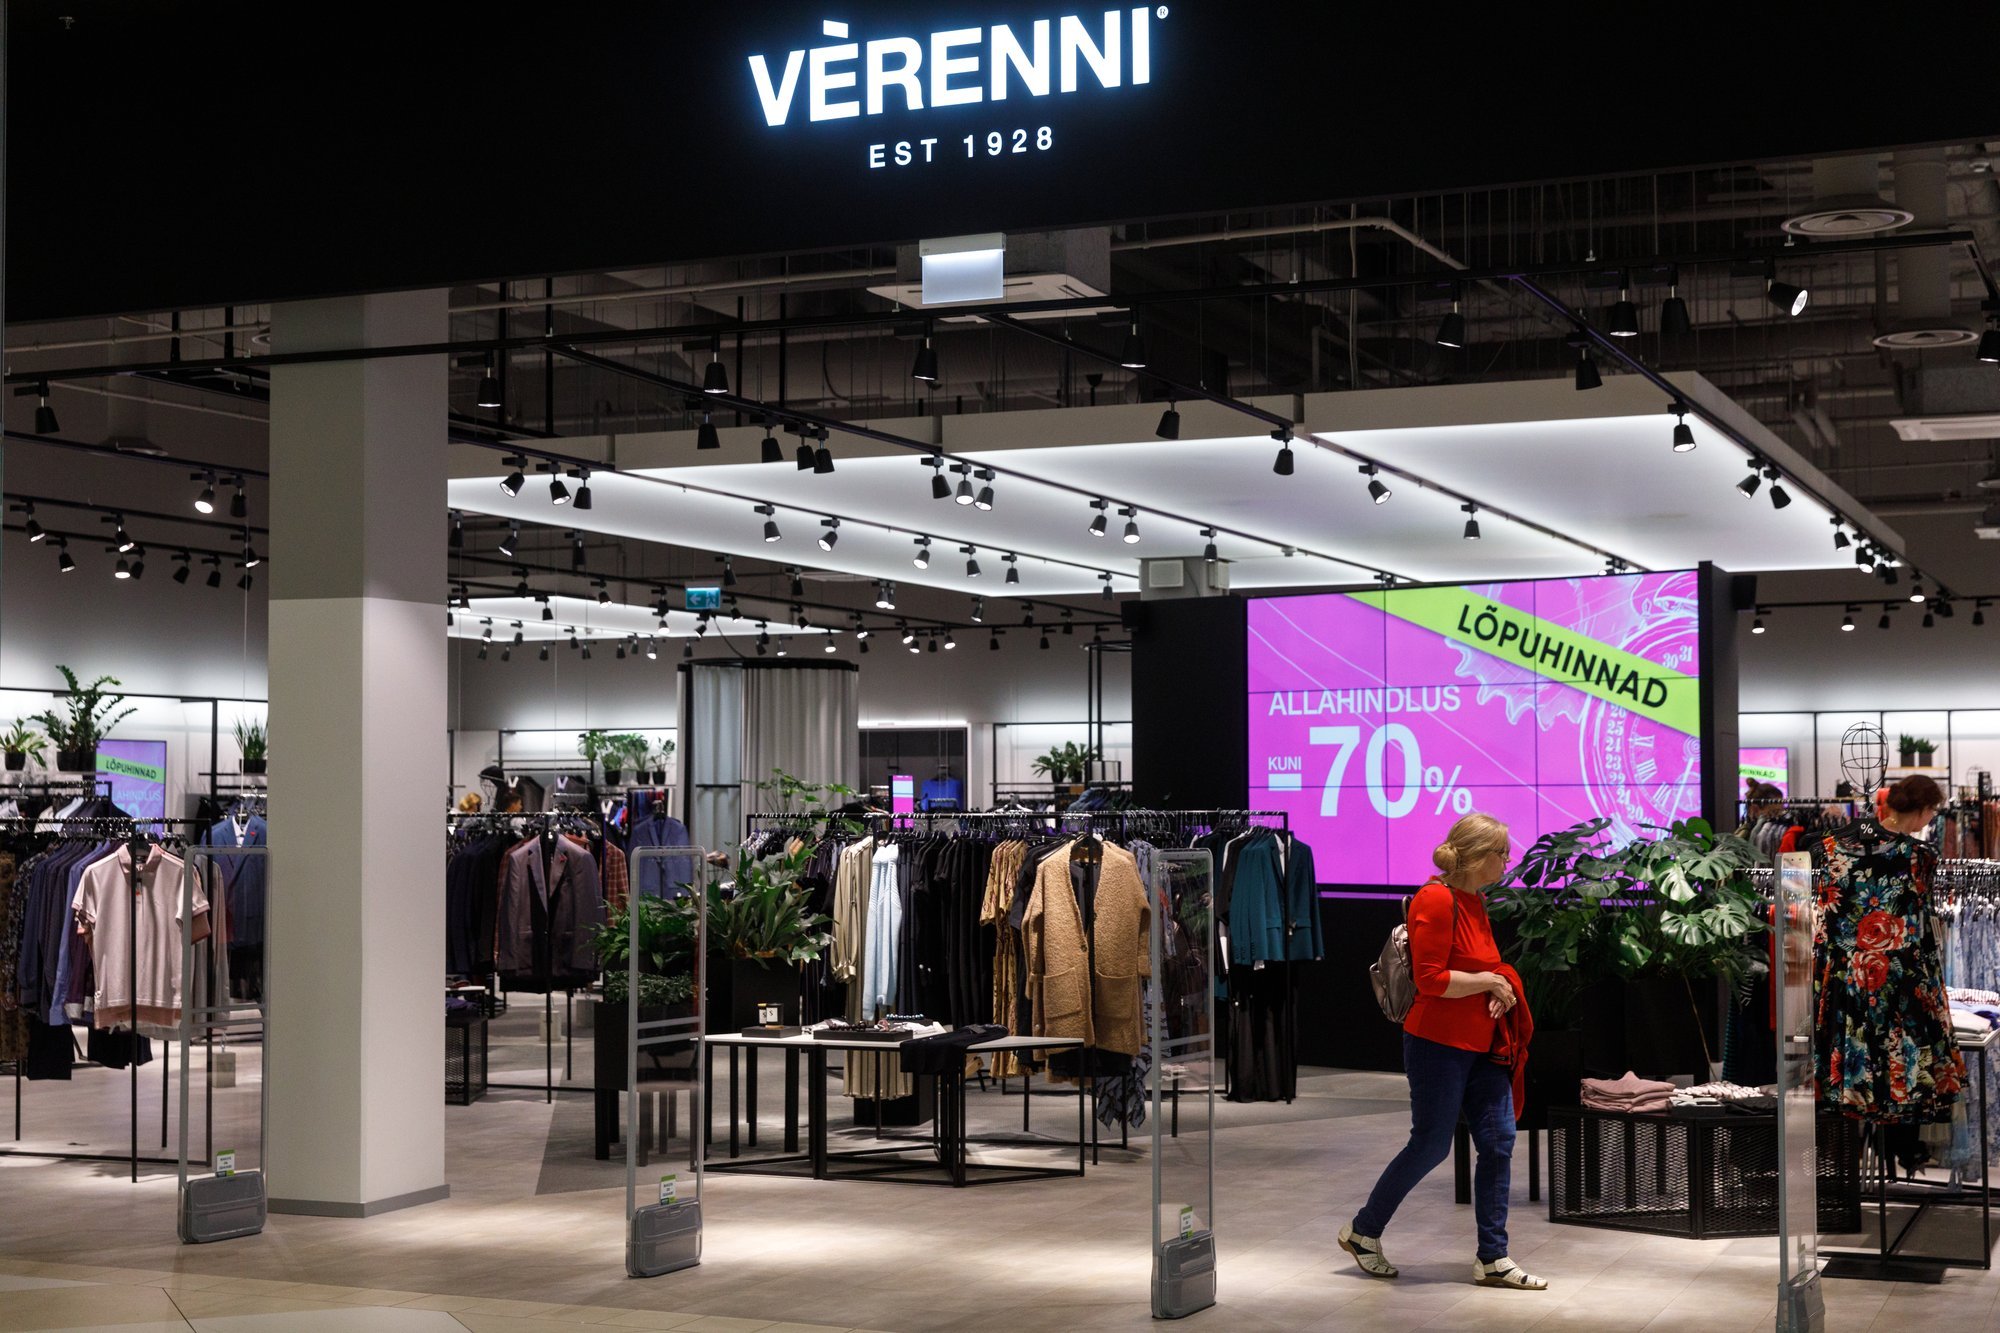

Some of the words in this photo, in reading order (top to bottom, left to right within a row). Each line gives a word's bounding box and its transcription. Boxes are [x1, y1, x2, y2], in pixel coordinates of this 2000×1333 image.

[869, 138, 938, 169] EST
[963, 126, 1054, 158] 1928
[1457, 604, 1668, 708] LÕPUHINNAD
[1268, 685, 1461, 716] ALLAHINDLUS
[106, 759, 157, 779] LÕPUHINNAD
[1268, 757, 1302, 771] KUNI
